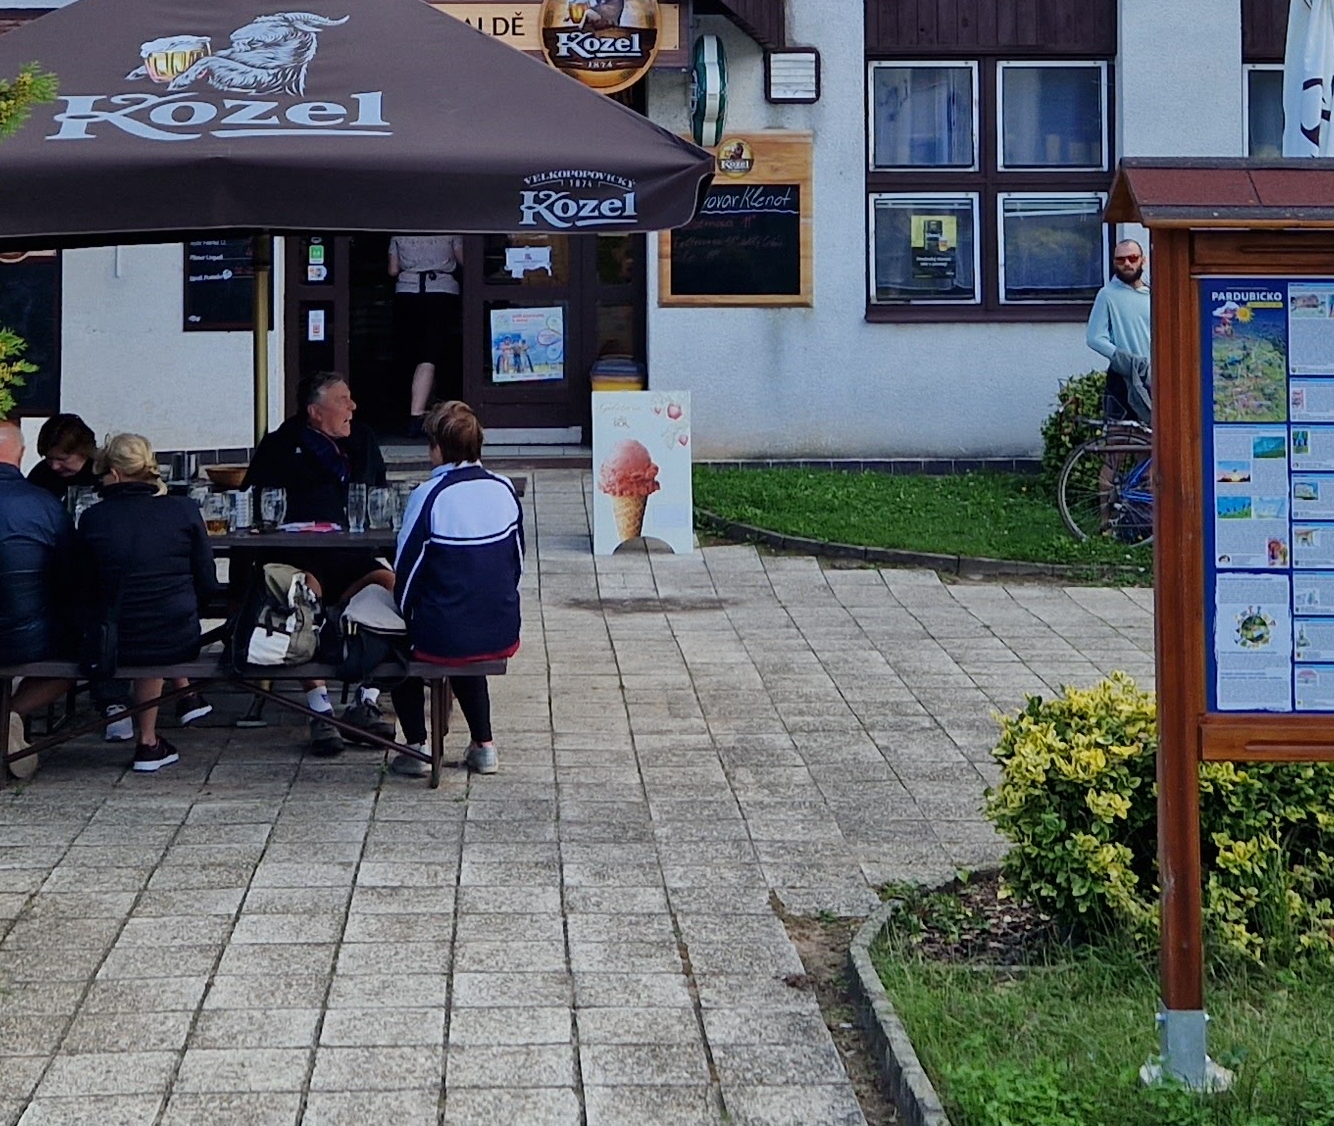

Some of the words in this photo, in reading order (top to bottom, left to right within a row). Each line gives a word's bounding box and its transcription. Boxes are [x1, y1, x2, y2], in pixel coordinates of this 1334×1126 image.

[465, 11, 526, 36] LDĚ
[555, 31, 643, 59] Kozel
[45, 91, 392, 141] Kozel
[518, 190, 638, 229] Kozel
[739, 185, 792, 209] Klenot
[1211, 291, 1283, 302] PARDUBICKO
